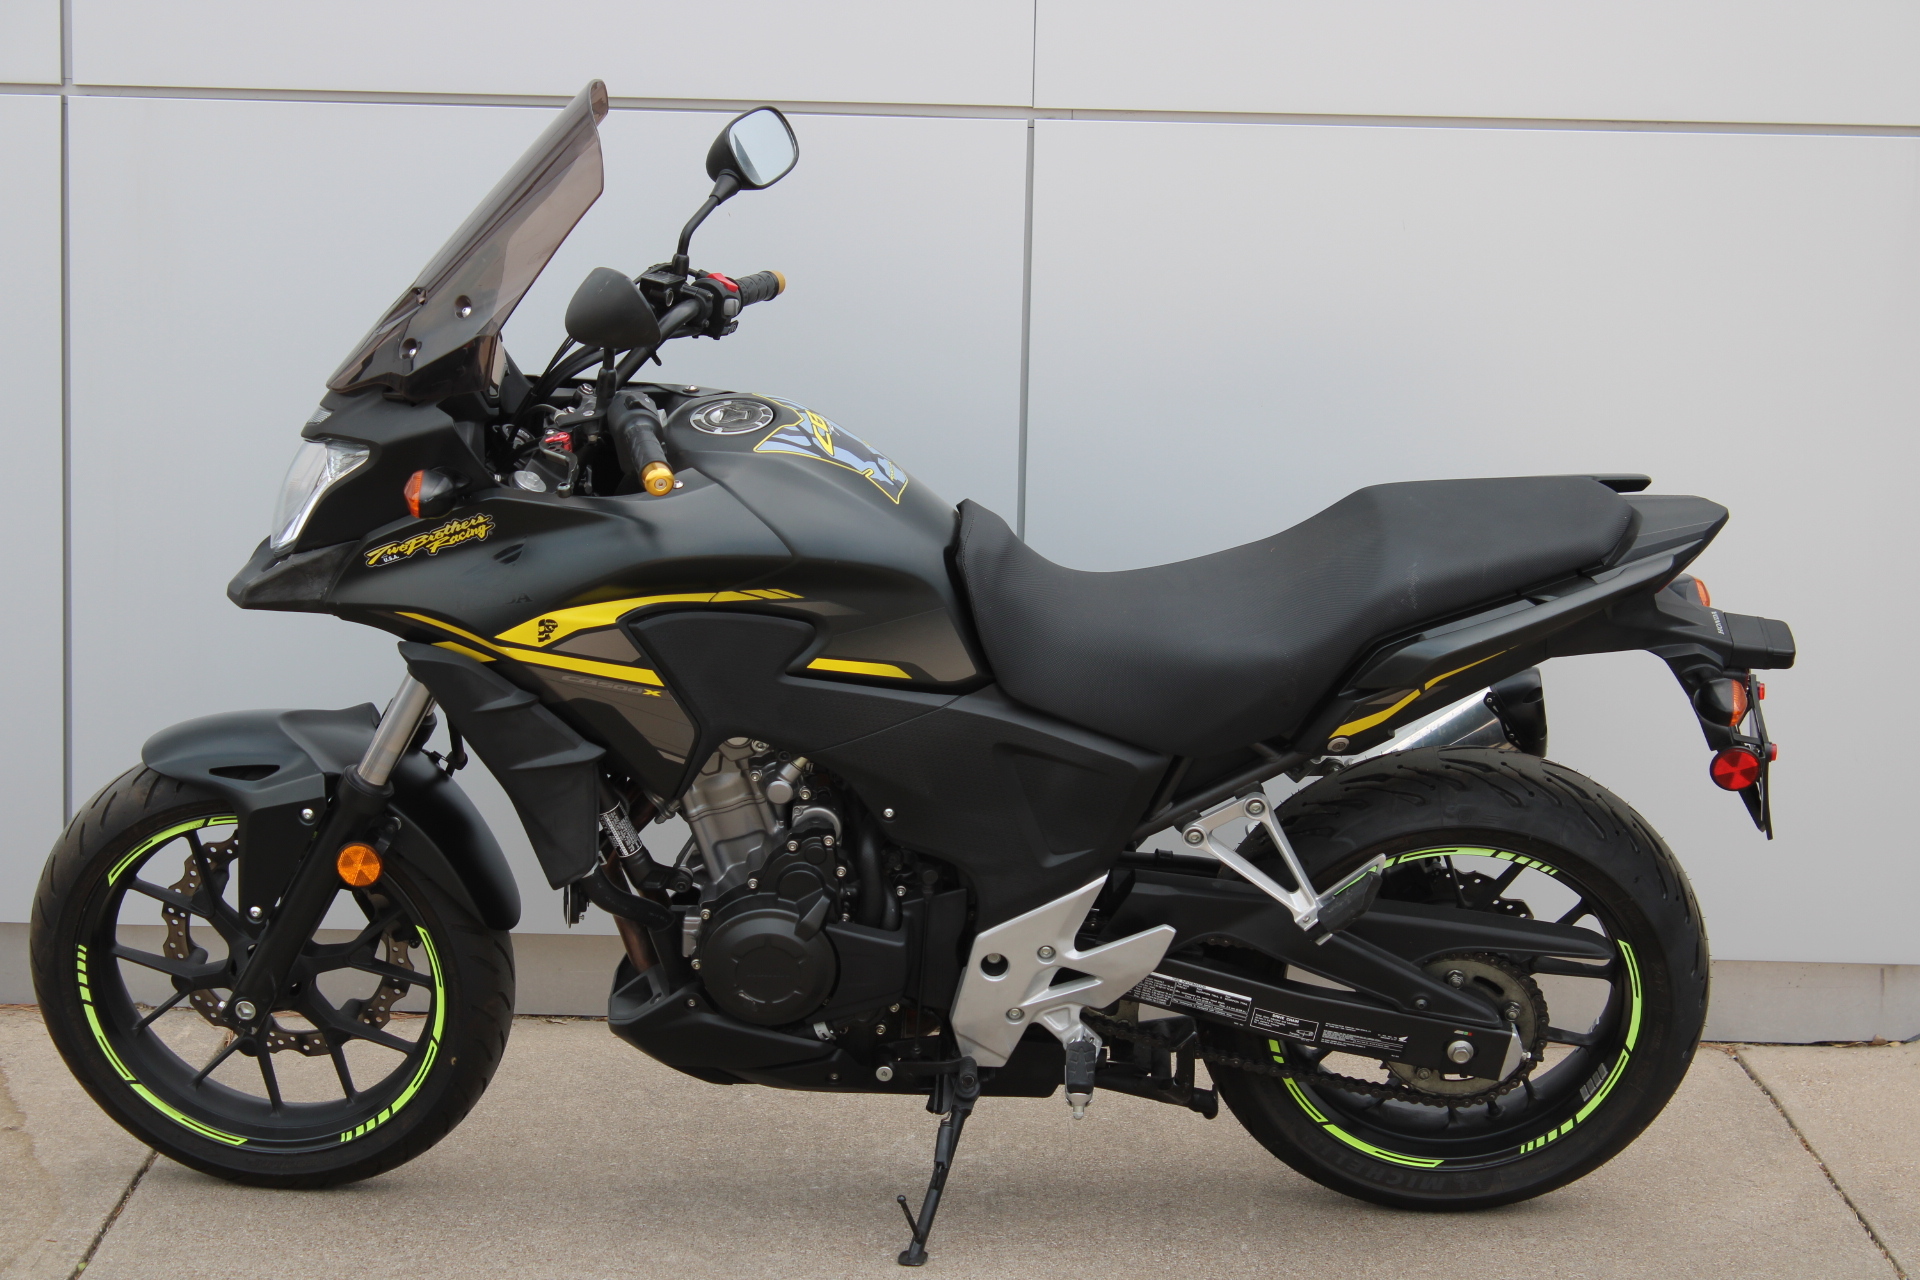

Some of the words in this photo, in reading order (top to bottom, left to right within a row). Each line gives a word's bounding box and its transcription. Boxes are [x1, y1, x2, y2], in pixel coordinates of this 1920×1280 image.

[404, 515, 490, 555] Brothers
[426, 524, 493, 553] Racing
[1711, 611, 1725, 635] HONDA
